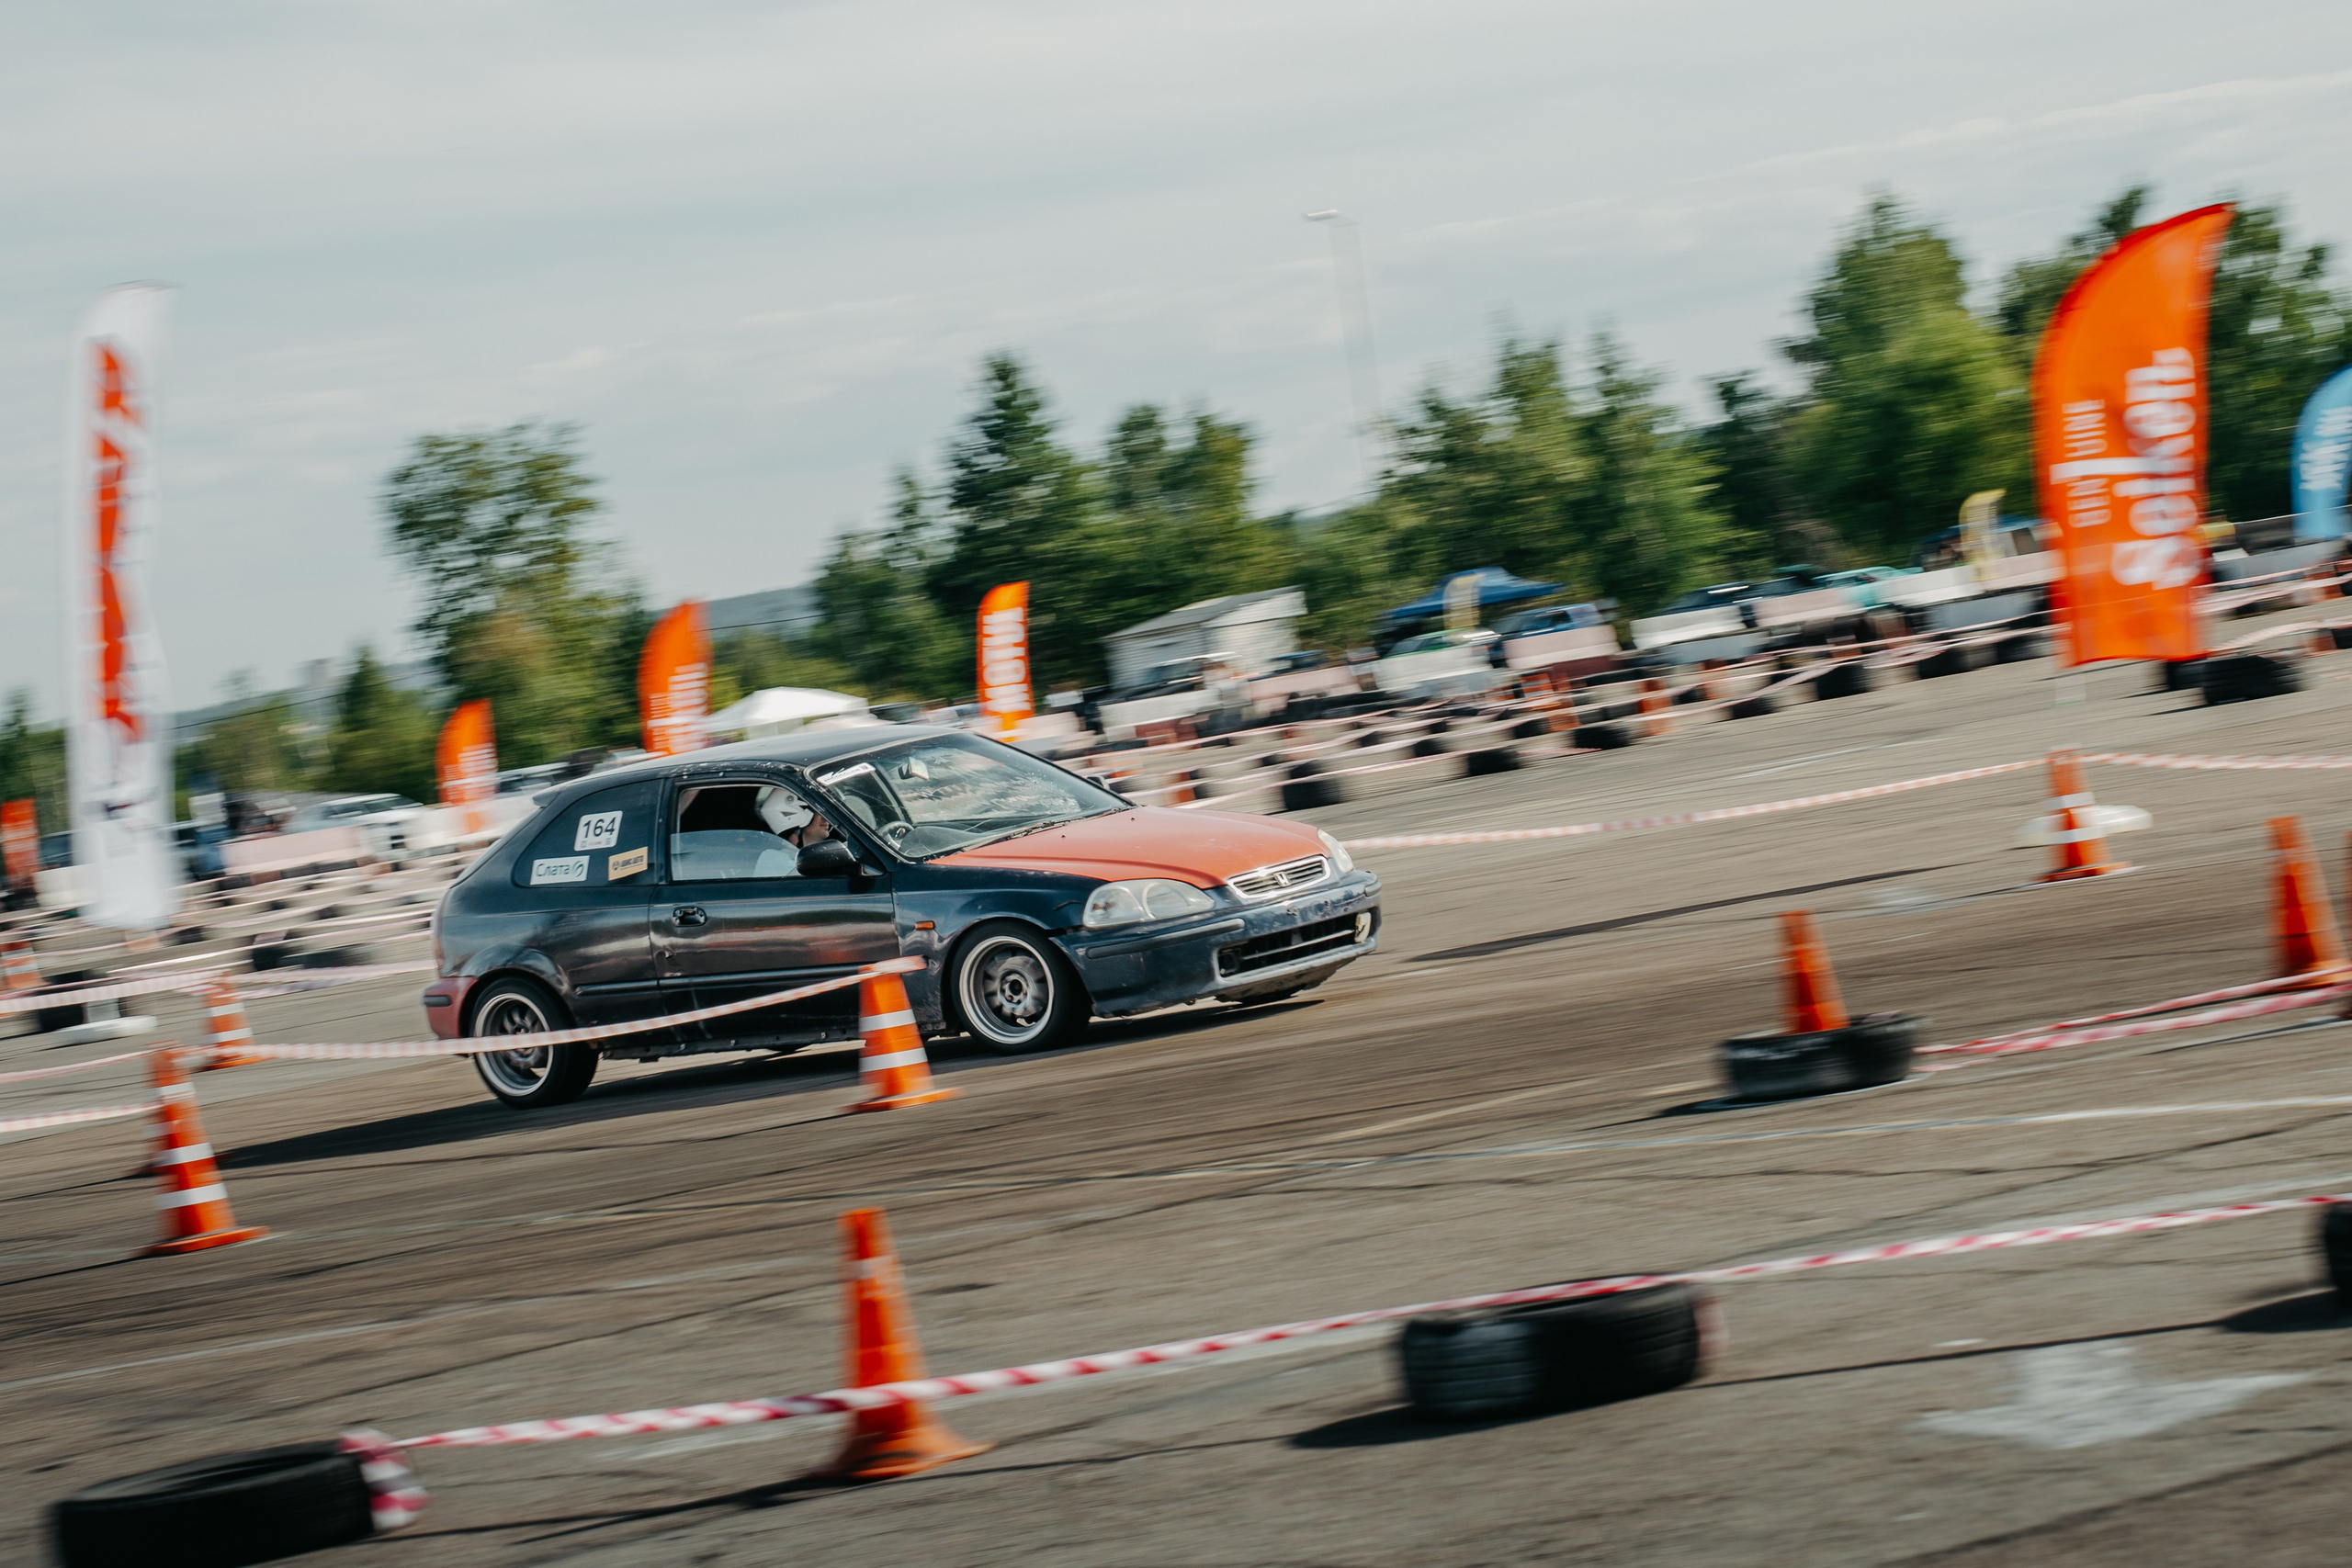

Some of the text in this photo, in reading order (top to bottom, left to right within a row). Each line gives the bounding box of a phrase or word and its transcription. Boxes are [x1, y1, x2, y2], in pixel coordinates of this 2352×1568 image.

[982, 607, 1031, 714] MOTUL
[582, 817, 616, 838] 164
[536, 863, 570, 877] Слата
